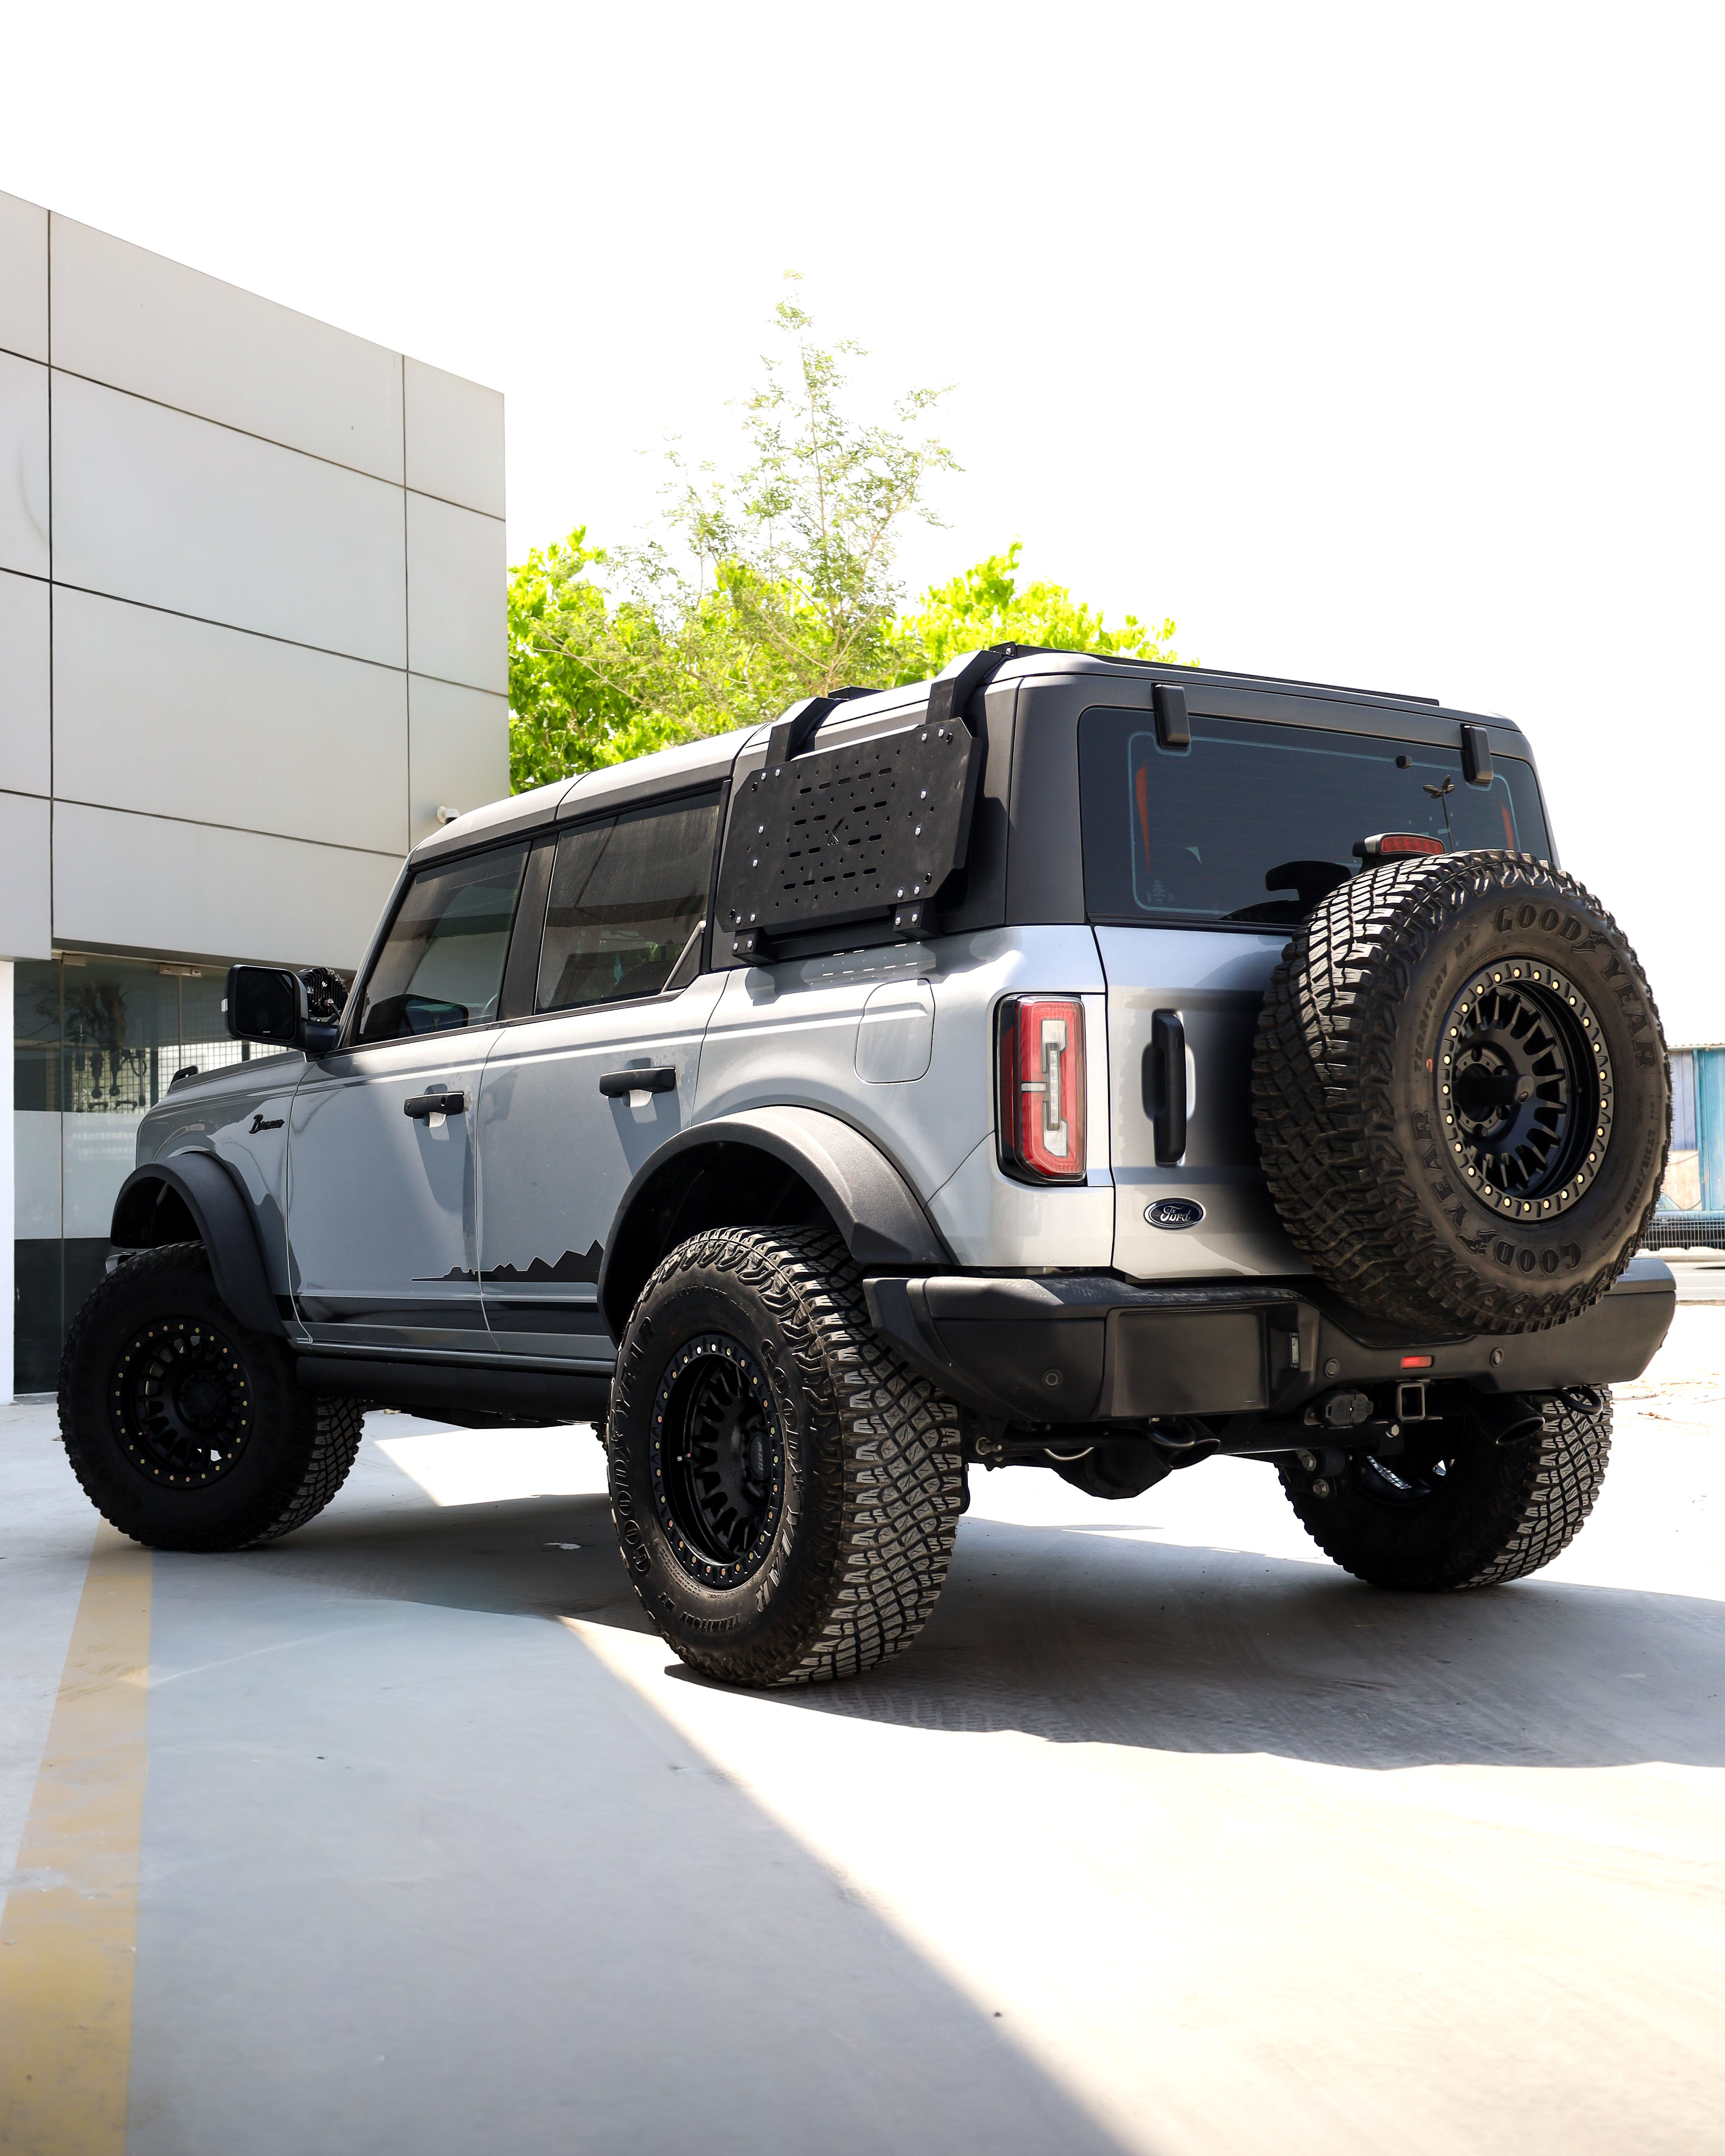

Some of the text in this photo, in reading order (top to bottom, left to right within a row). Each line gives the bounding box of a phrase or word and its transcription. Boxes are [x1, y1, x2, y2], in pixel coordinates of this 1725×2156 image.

[1414, 962, 1448, 1072] TERRITORY
[1496, 904, 1656, 1069] GOODYEAR
[249, 1114, 285, 1134] Bronco
[1160, 1206, 1190, 1221] Ford
[1414, 1110, 1582, 1274] GOODYEAR
[613, 1316, 657, 1572] GOODYEAR
[679, 1611, 741, 1632] TERRITORY
